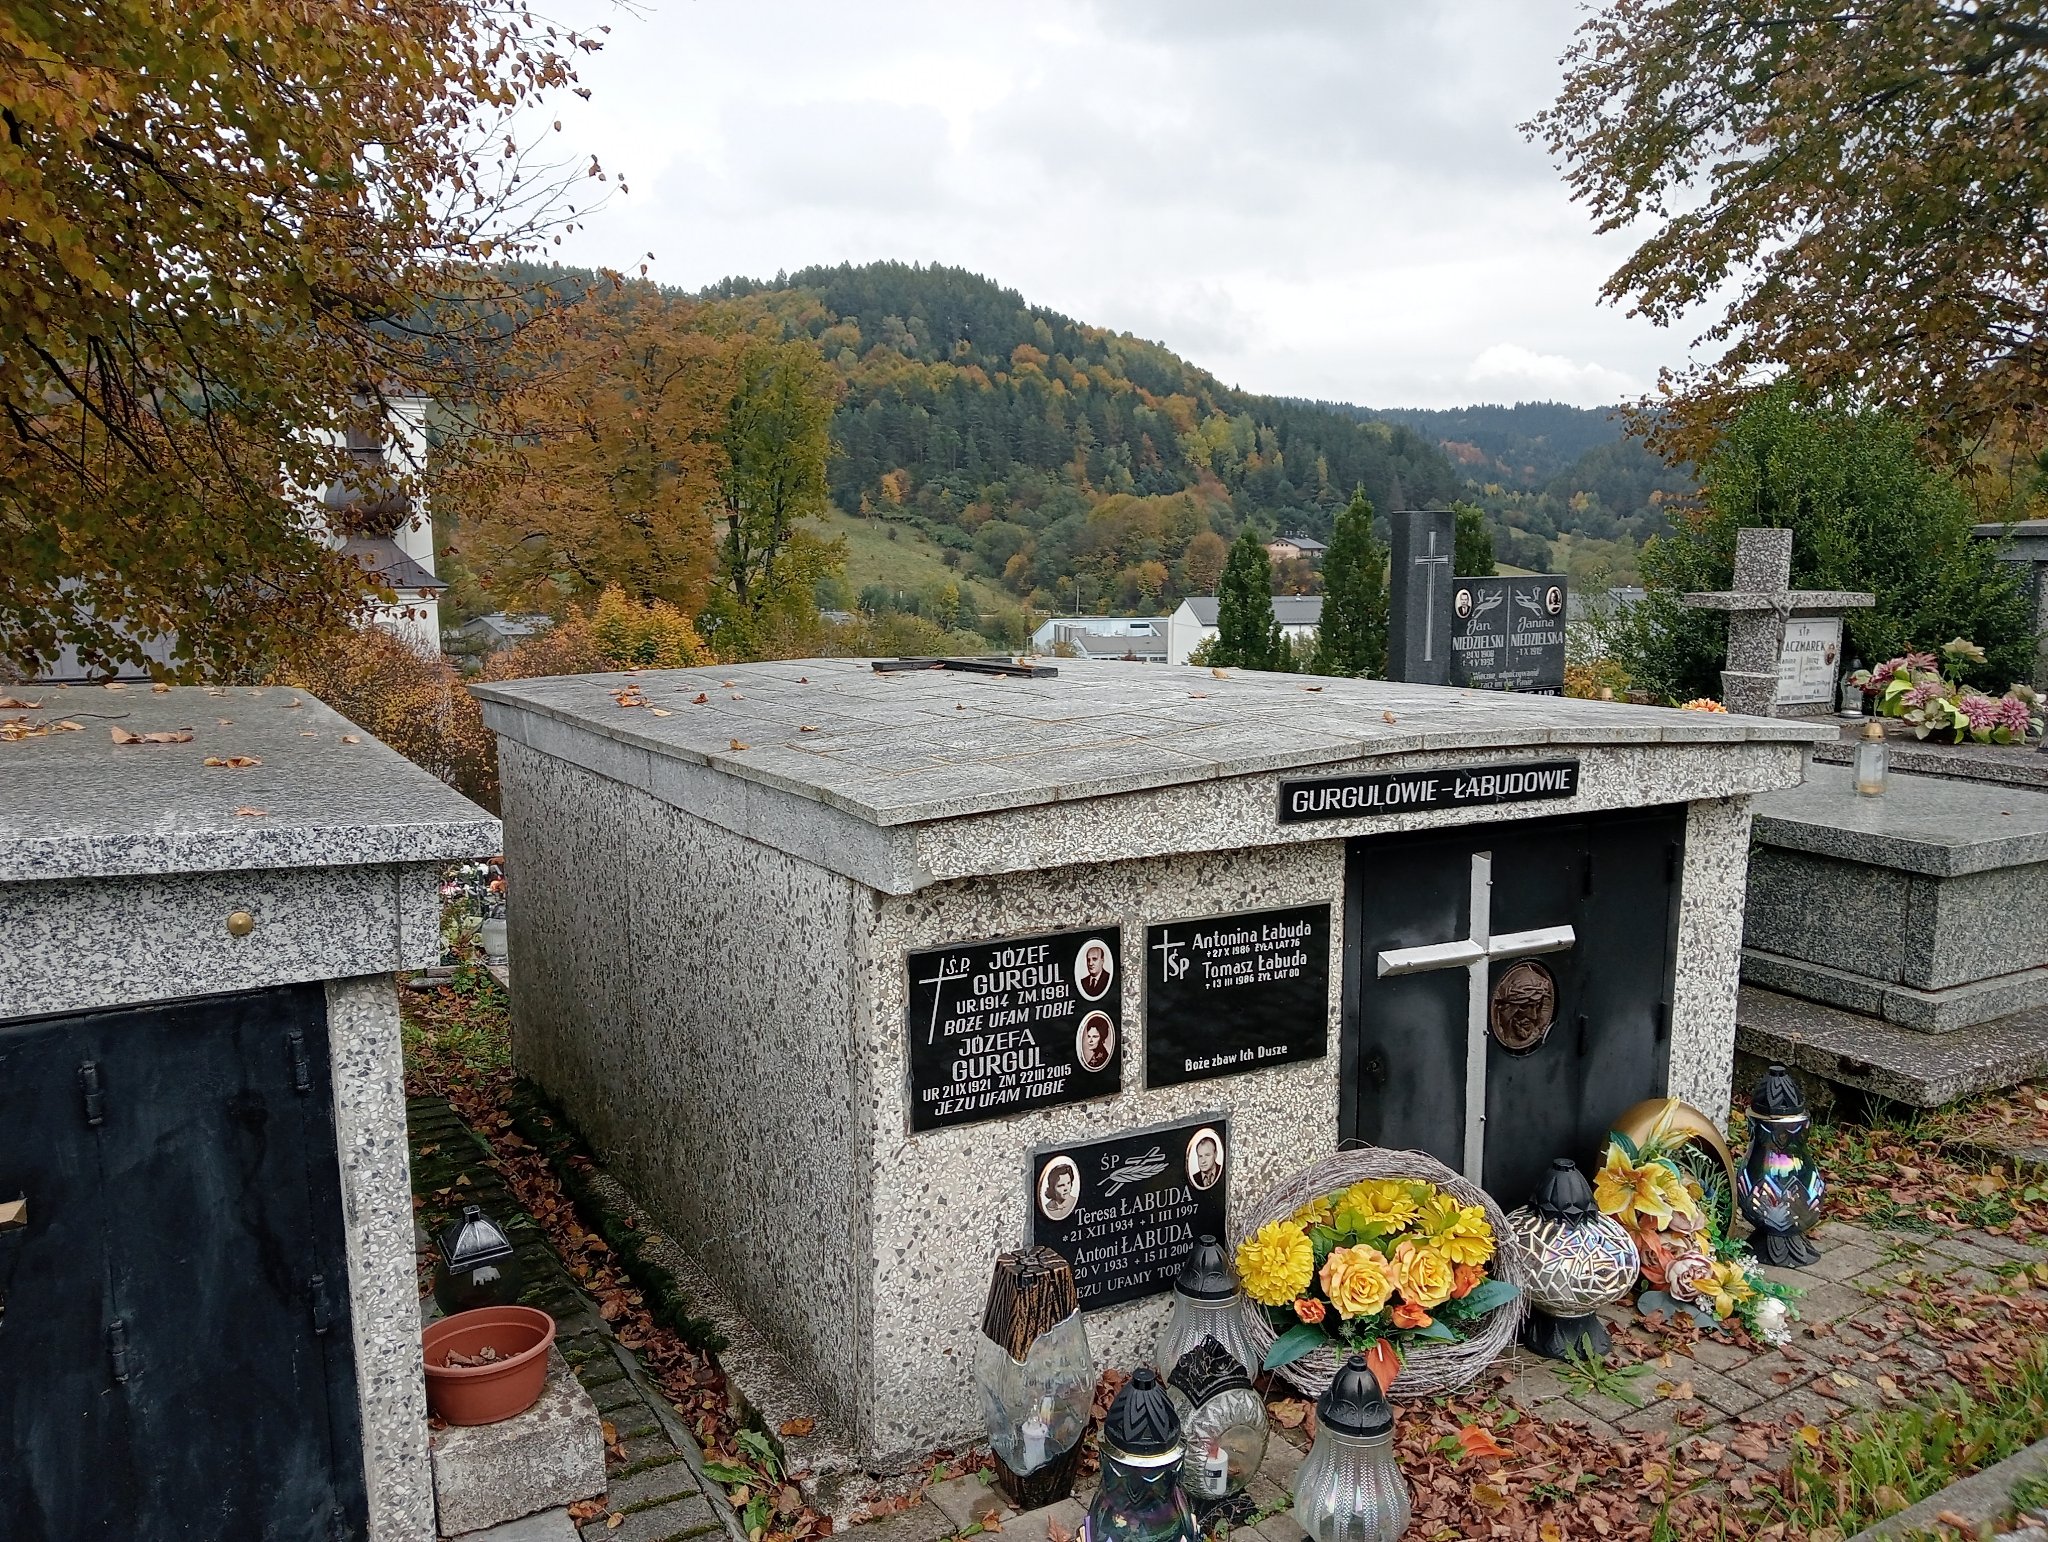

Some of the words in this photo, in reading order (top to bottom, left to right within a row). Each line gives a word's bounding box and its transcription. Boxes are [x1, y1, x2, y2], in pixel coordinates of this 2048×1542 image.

[1466, 619, 1492, 636] Jan
[1517, 616, 1555, 633] Janina
[1452, 634, 1504, 651] NIEDZIELSKI
[1510, 631, 1564, 647] NIEDZIELSKA
[1782, 640, 1825, 652] ACZMAREK
[1192, 928, 1258, 950] Antonina
[1262, 920, 1312, 942] Łabuda
[1232, 945, 1250, 955] 1986
[1275, 940, 1289, 950] LAT
[989, 945, 1049, 970] JÓZEF
[1202, 961, 1254, 979] Tomasz
[1258, 950, 1307, 971] Łabuda
[973, 963, 1064, 996] GURGUL
[1236, 974, 1254, 985] 1986
[1274, 969, 1288, 980] LAT
[989, 1007, 1029, 1028] UFAM
[1035, 1000, 1076, 1021] TOBIE
[959, 1029, 1036, 1057] JÓZEFA
[952, 1047, 1046, 1082] GURGUL
[1185, 1057, 1210, 1072] Boże
[1211, 1053, 1238, 1067] zbaw
[1240, 1048, 1254, 1062] Ich
[1257, 1045, 1288, 1059] Dusze
[923, 1088, 940, 1102] UR
[999, 1074, 1016, 1088] ZM
[1047, 1064, 1072, 1079] 2015
[935, 1096, 976, 1116] JEZU
[979, 1088, 1020, 1108] UFAM
[1025, 1079, 1066, 1099] TOBIE
[1074, 1205, 1117, 1226] Teresa
[1120, 1184, 1193, 1216] ŁABUDA
[1086, 1224, 1106, 1239] XII
[1110, 1219, 1134, 1234] 1934
[1158, 1210, 1172, 1222] III
[1176, 1203, 1199, 1218] 1997
[1073, 1240, 1118, 1266] Antoni
[1120, 1222, 1194, 1254] ŁABUDA
[1090, 1264, 1101, 1275] V
[1104, 1257, 1128, 1273] 1933
[1144, 1250, 1156, 1263] 15
[1158, 1248, 1168, 1260] II
[1076, 1281, 1102, 1299] EZU
[1107, 1269, 1152, 1291] UFAMY
[1157, 1261, 1186, 1279] TOB
